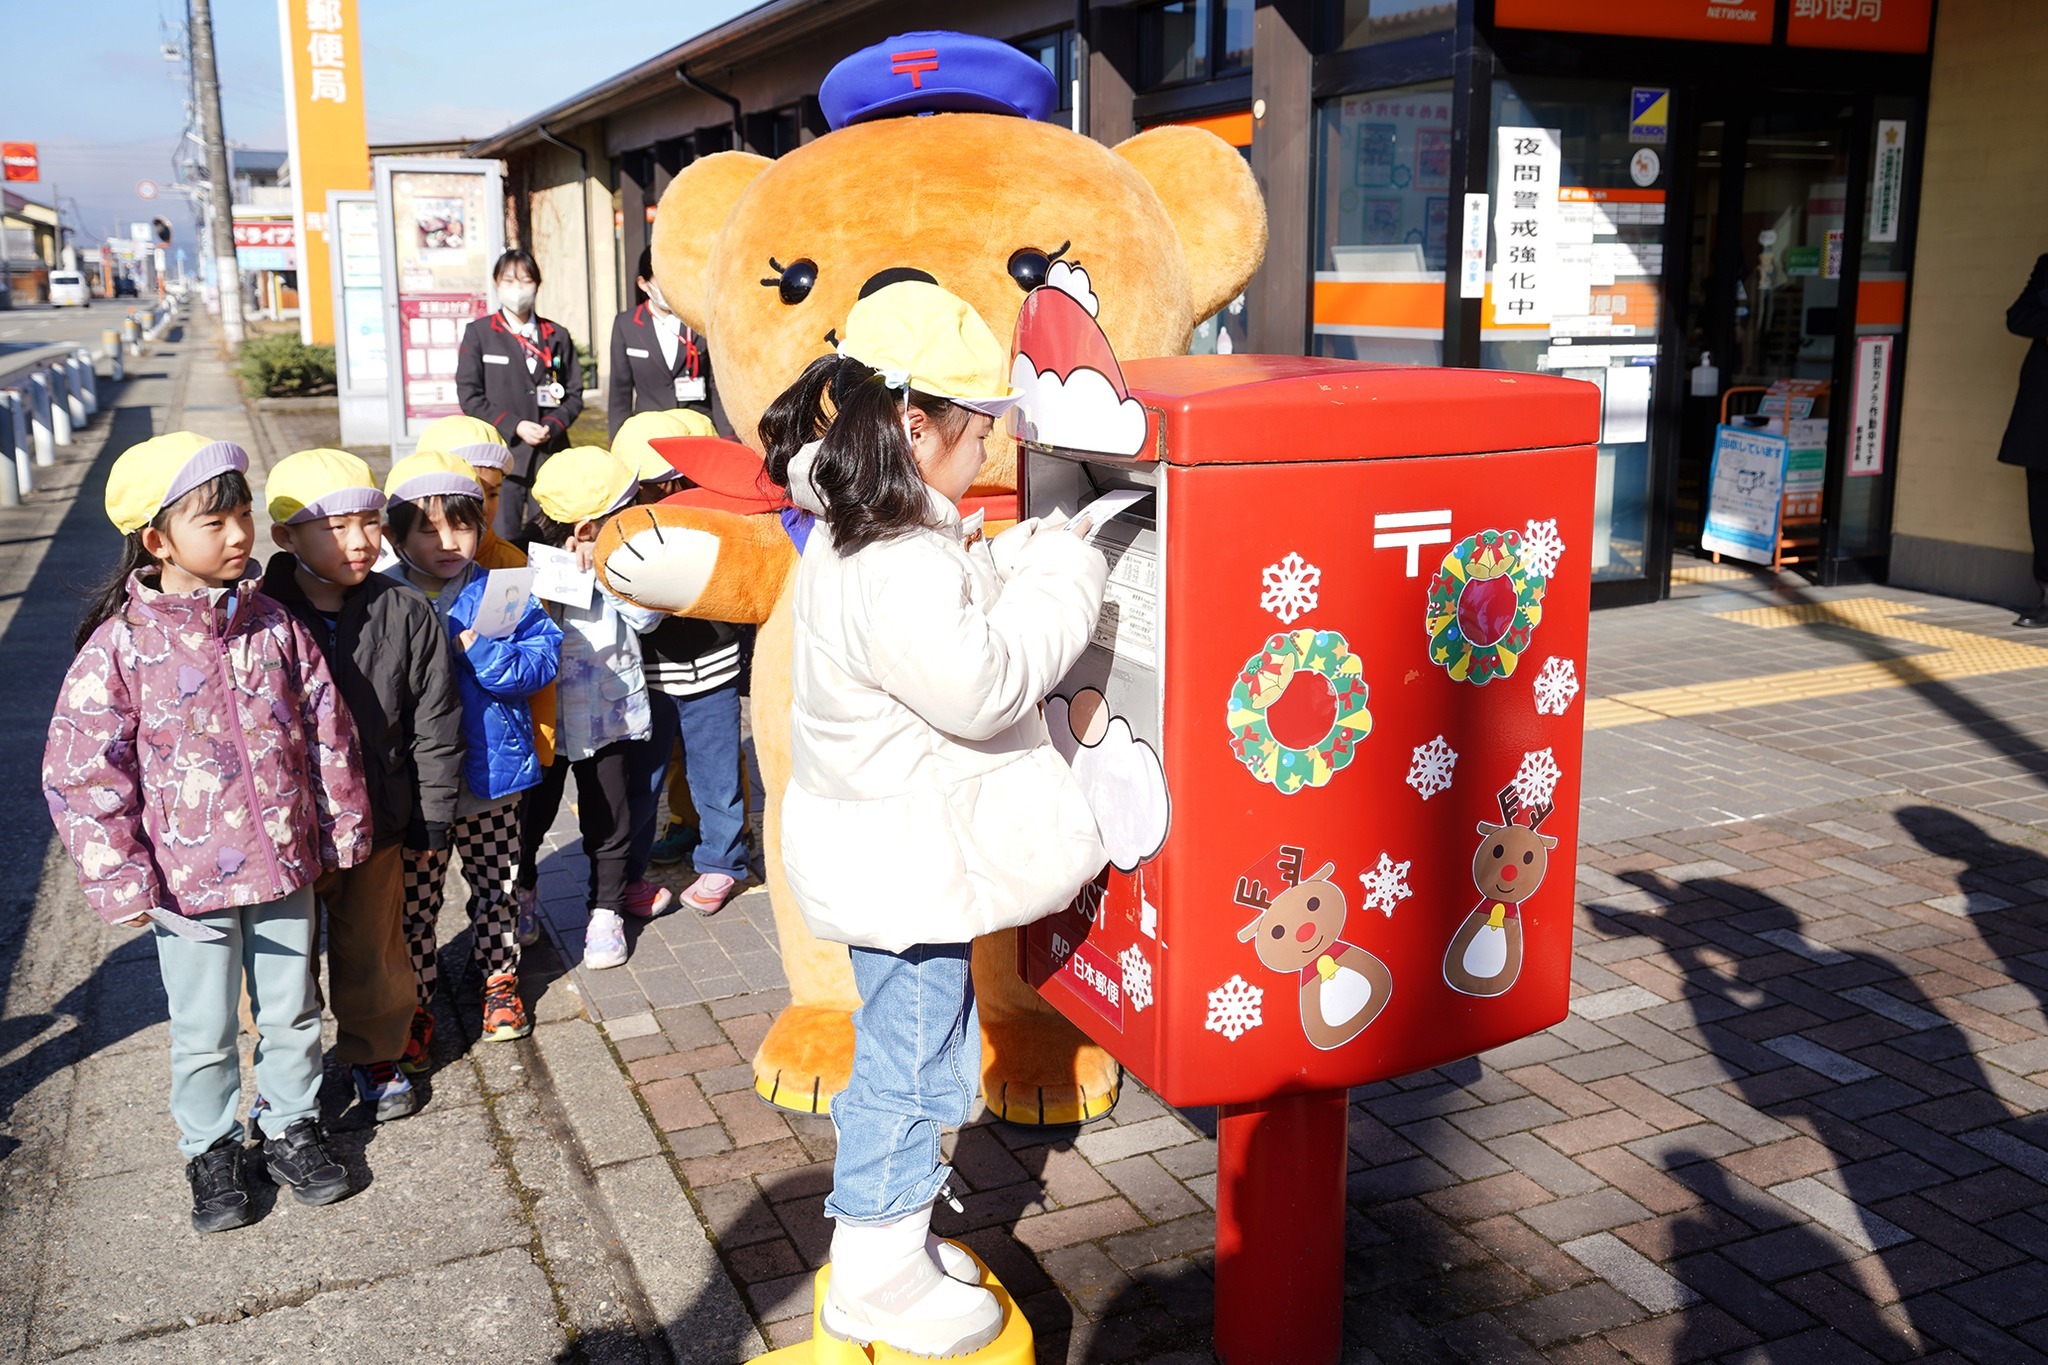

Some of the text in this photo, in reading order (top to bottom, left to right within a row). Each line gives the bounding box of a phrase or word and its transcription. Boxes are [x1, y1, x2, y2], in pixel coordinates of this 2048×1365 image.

[1706, 6, 1758, 21] NETWORK
[1794, 0, 1881, 22] 郵便局
[305, 0, 346, 103] 郵便局
[233, 225, 294, 246] ドライブ
[1508, 137, 1542, 316] 夜間警戒強化中
[1720, 438, 1782, 459] 回収しています
[1074, 880, 1109, 930] OST
[1052, 932, 1070, 957] JP
[1074, 952, 1119, 1008] 日本郵便
